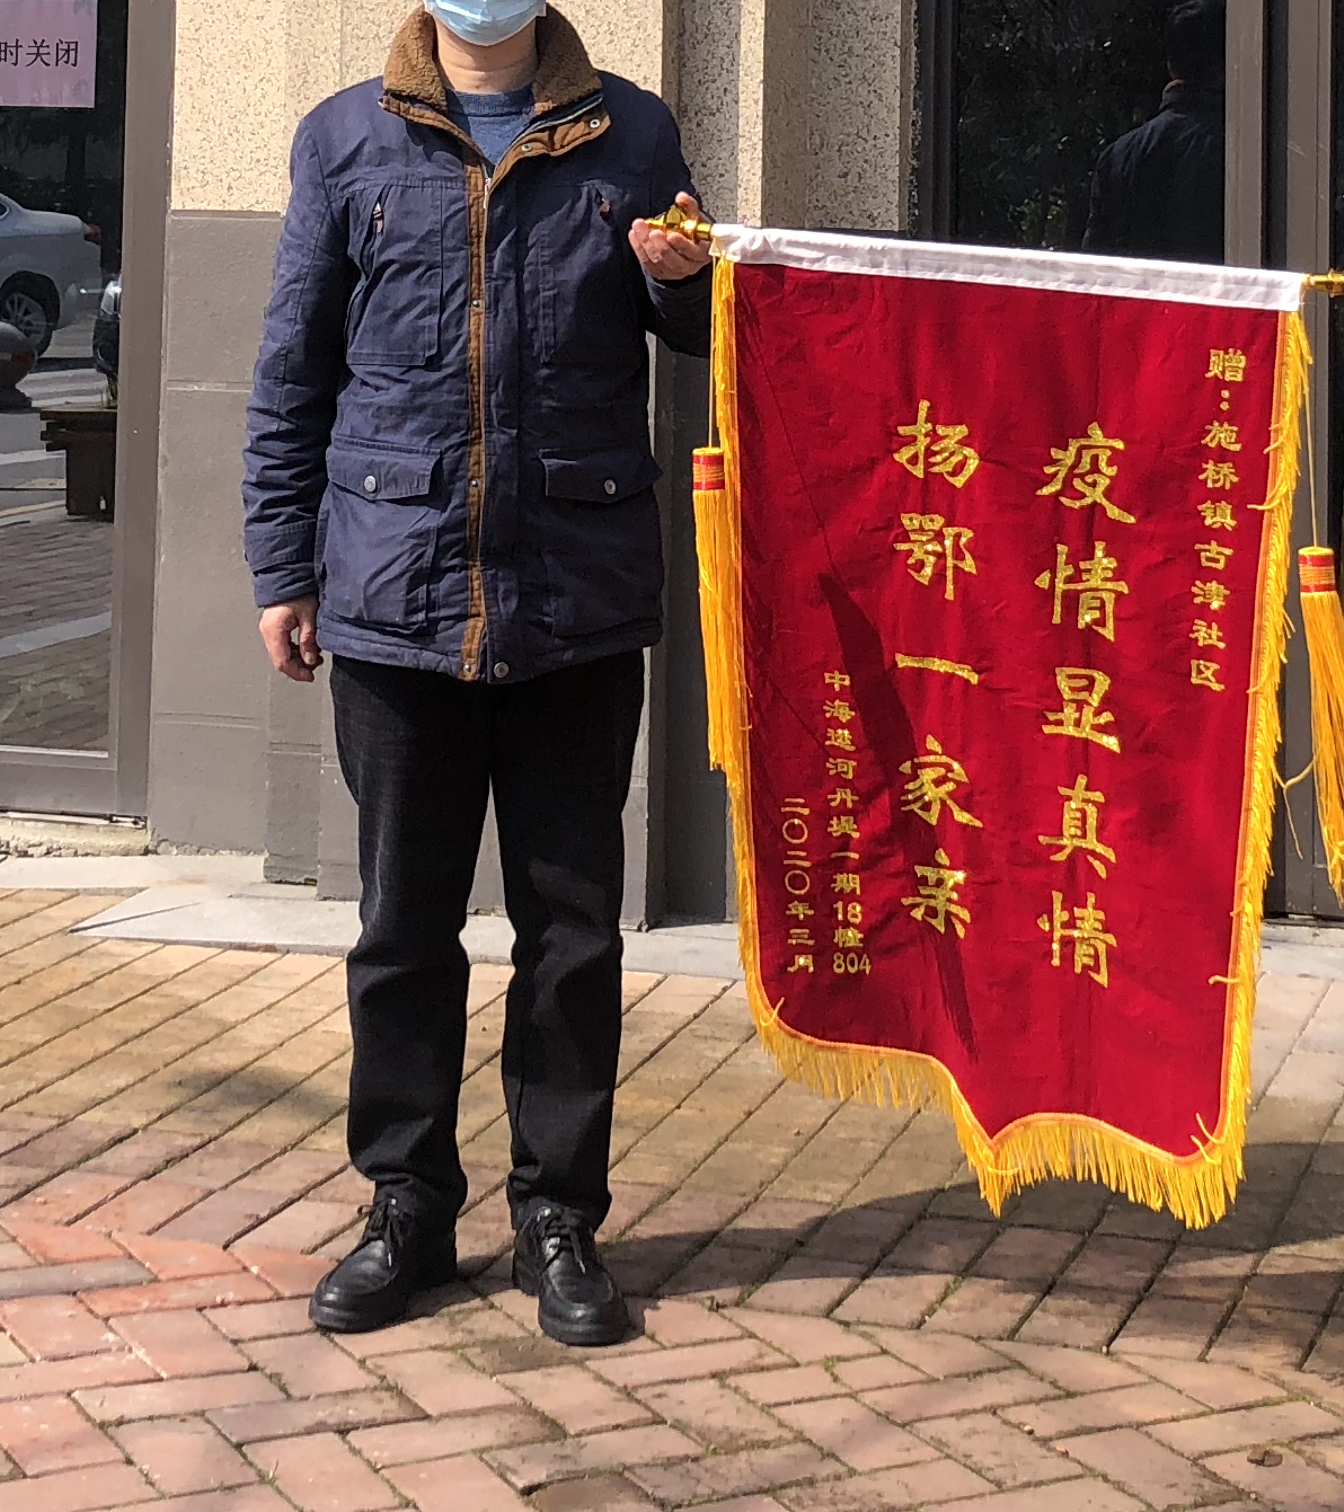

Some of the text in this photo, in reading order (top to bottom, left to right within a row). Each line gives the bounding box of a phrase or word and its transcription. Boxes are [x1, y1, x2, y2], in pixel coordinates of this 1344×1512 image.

[893, 399, 983, 939] 扬鄂一家亲
[1034, 421, 1137, 988] 疫情显真情
[1190, 348, 1247, 690] 赠：施桥镇古津社区
